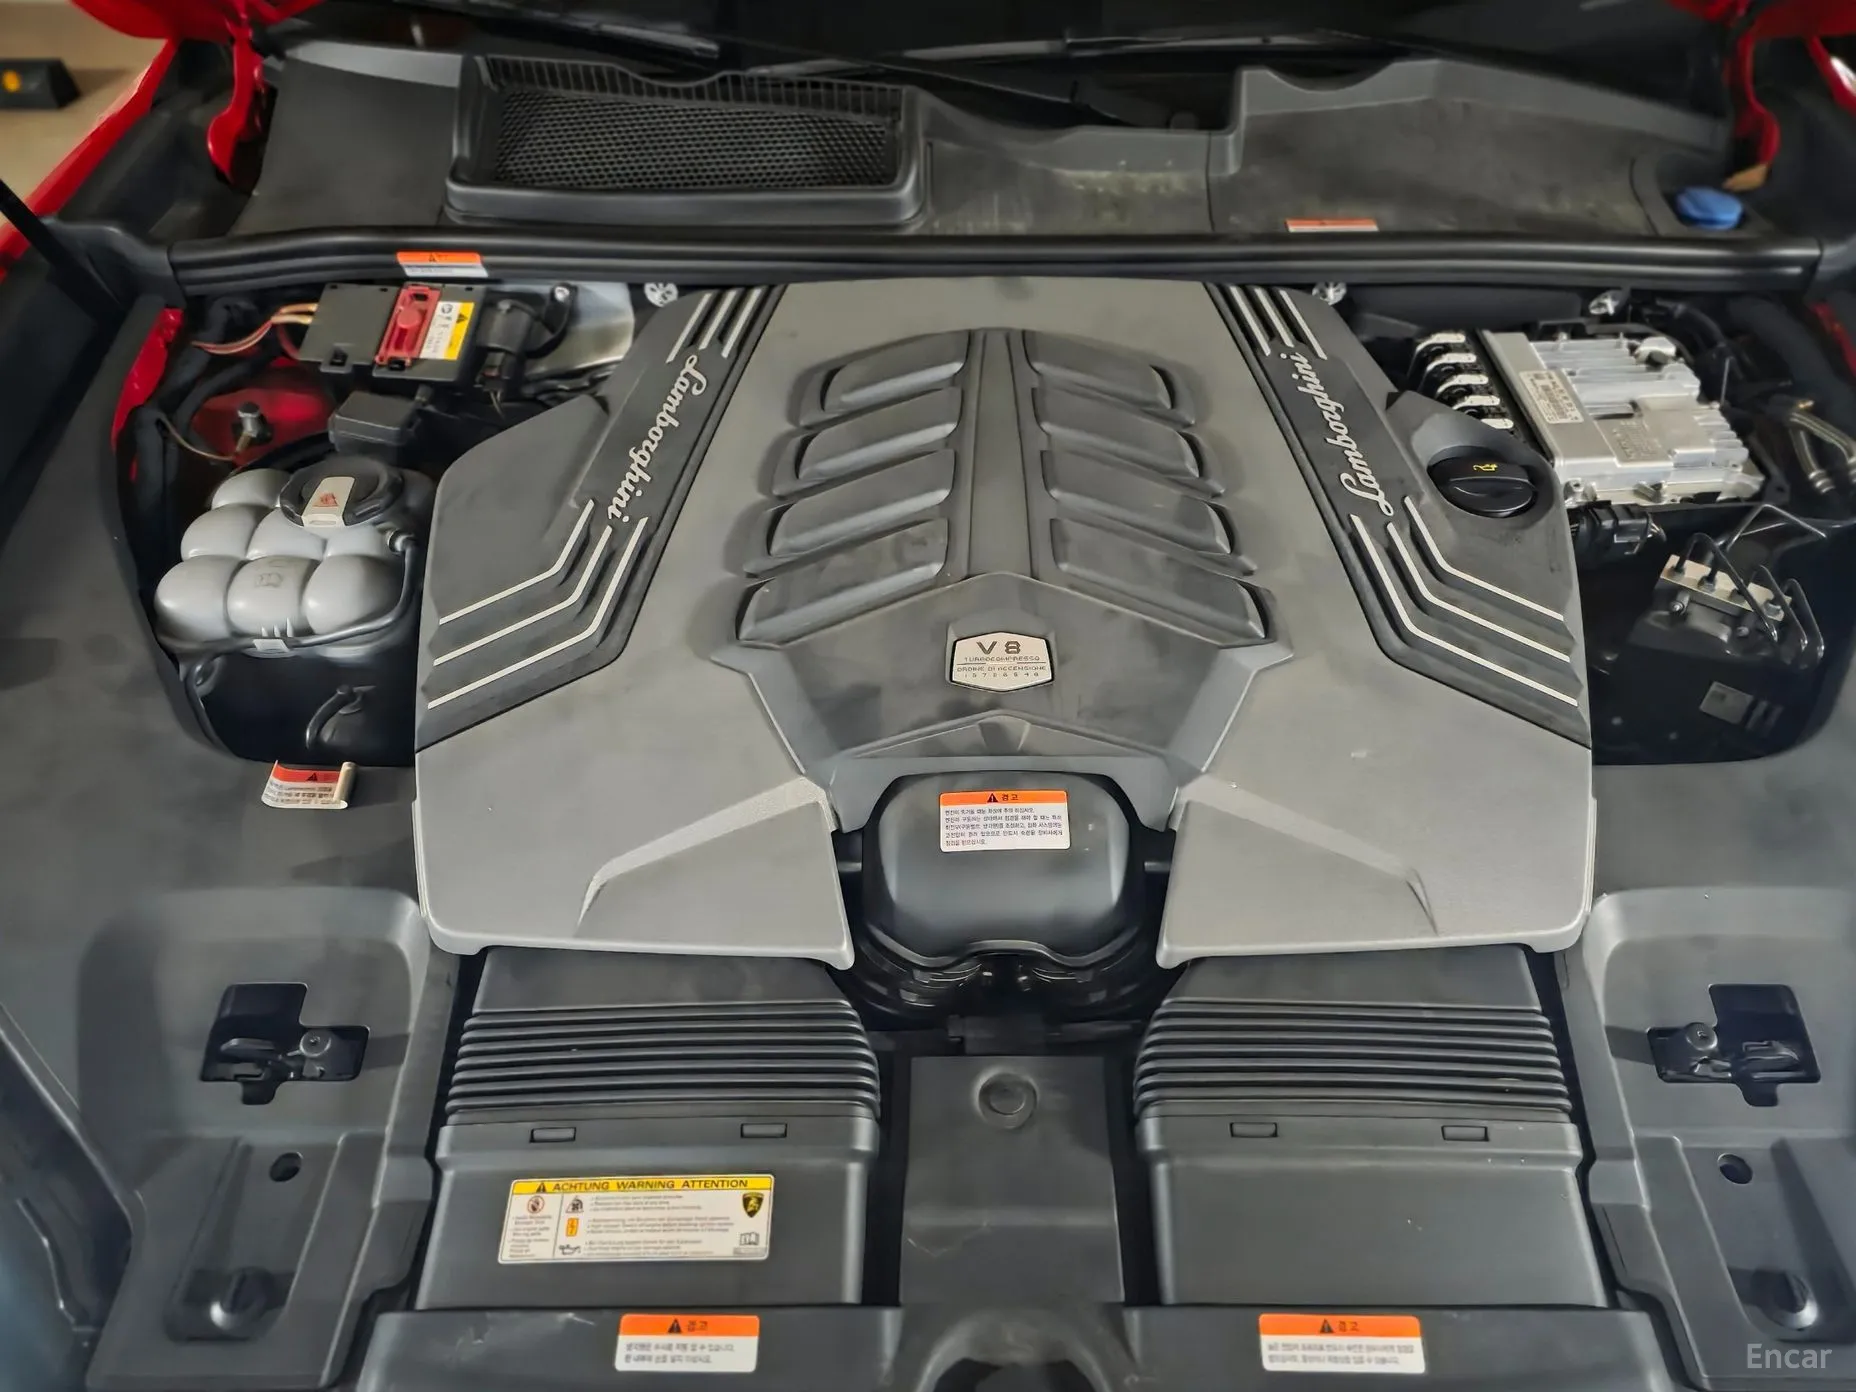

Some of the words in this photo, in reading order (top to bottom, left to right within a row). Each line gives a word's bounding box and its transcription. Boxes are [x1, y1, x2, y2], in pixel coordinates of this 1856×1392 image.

[607, 354, 707, 523] Lamborghini
[1279, 352, 1394, 517] Lamborghini
[552, 1181, 609, 1191] ACHTUNG
[616, 1180, 675, 1190] WARNING
[681, 1179, 748, 1189] ATTENTION
